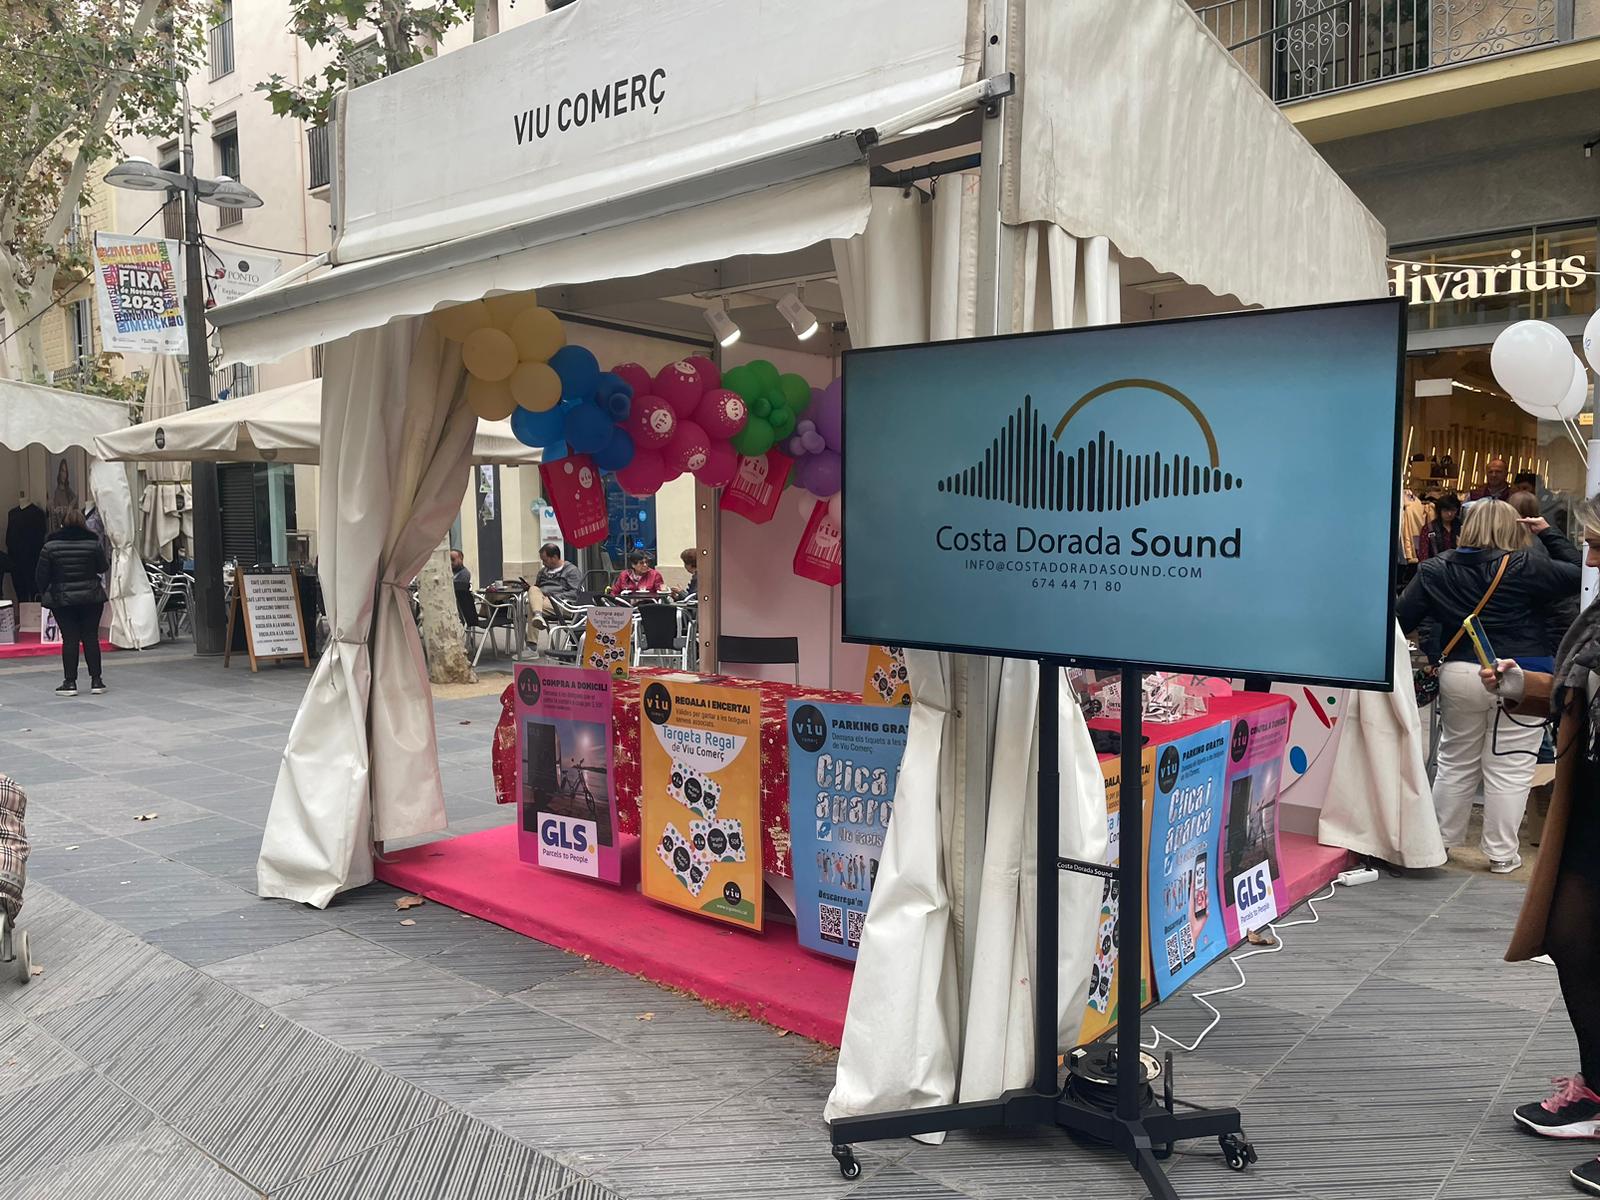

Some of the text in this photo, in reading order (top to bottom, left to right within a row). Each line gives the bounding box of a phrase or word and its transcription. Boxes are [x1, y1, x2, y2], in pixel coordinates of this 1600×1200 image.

[514, 68, 666, 146] VIU COMERÇ
[119, 269, 163, 291] FIRA
[228, 271, 259, 282] PONTO
[120, 294, 165, 314] 2023
[743, 459, 764, 475] viu
[819, 524, 839, 537] viu
[936, 525, 1241, 558] Costa Dorada Sound
[965, 559, 1202, 578] INFO@COSTADORADASOUND.COM
[1032, 578, 1122, 592] 674 44 71 80
[520, 678, 538, 692] viu
[647, 694, 668, 710] viu
[675, 696, 706, 708] REGALA
[712, 701, 750, 714] ENCERTA!
[796, 718, 823, 736] viu
[831, 719, 880, 732] PARKING
[662, 725, 735, 751] Targeta Regal
[1232, 731, 1248, 748] viu
[671, 743, 725, 762] de Viu Comerç
[840, 743, 849, 751] Viu
[850, 743, 872, 755] Comerç
[1182, 744, 1205, 761] PARKING
[1206, 737, 1224, 751] GRATIS
[816, 753, 888, 795] Clica
[1160, 759, 1178, 778] viu
[1168, 784, 1204, 824] Clica
[542, 848, 562, 859] Parcels
[570, 853, 588, 864] People
[1056, 862, 1114, 877] Costa Dorada Sound
[725, 887, 740, 899] viu
